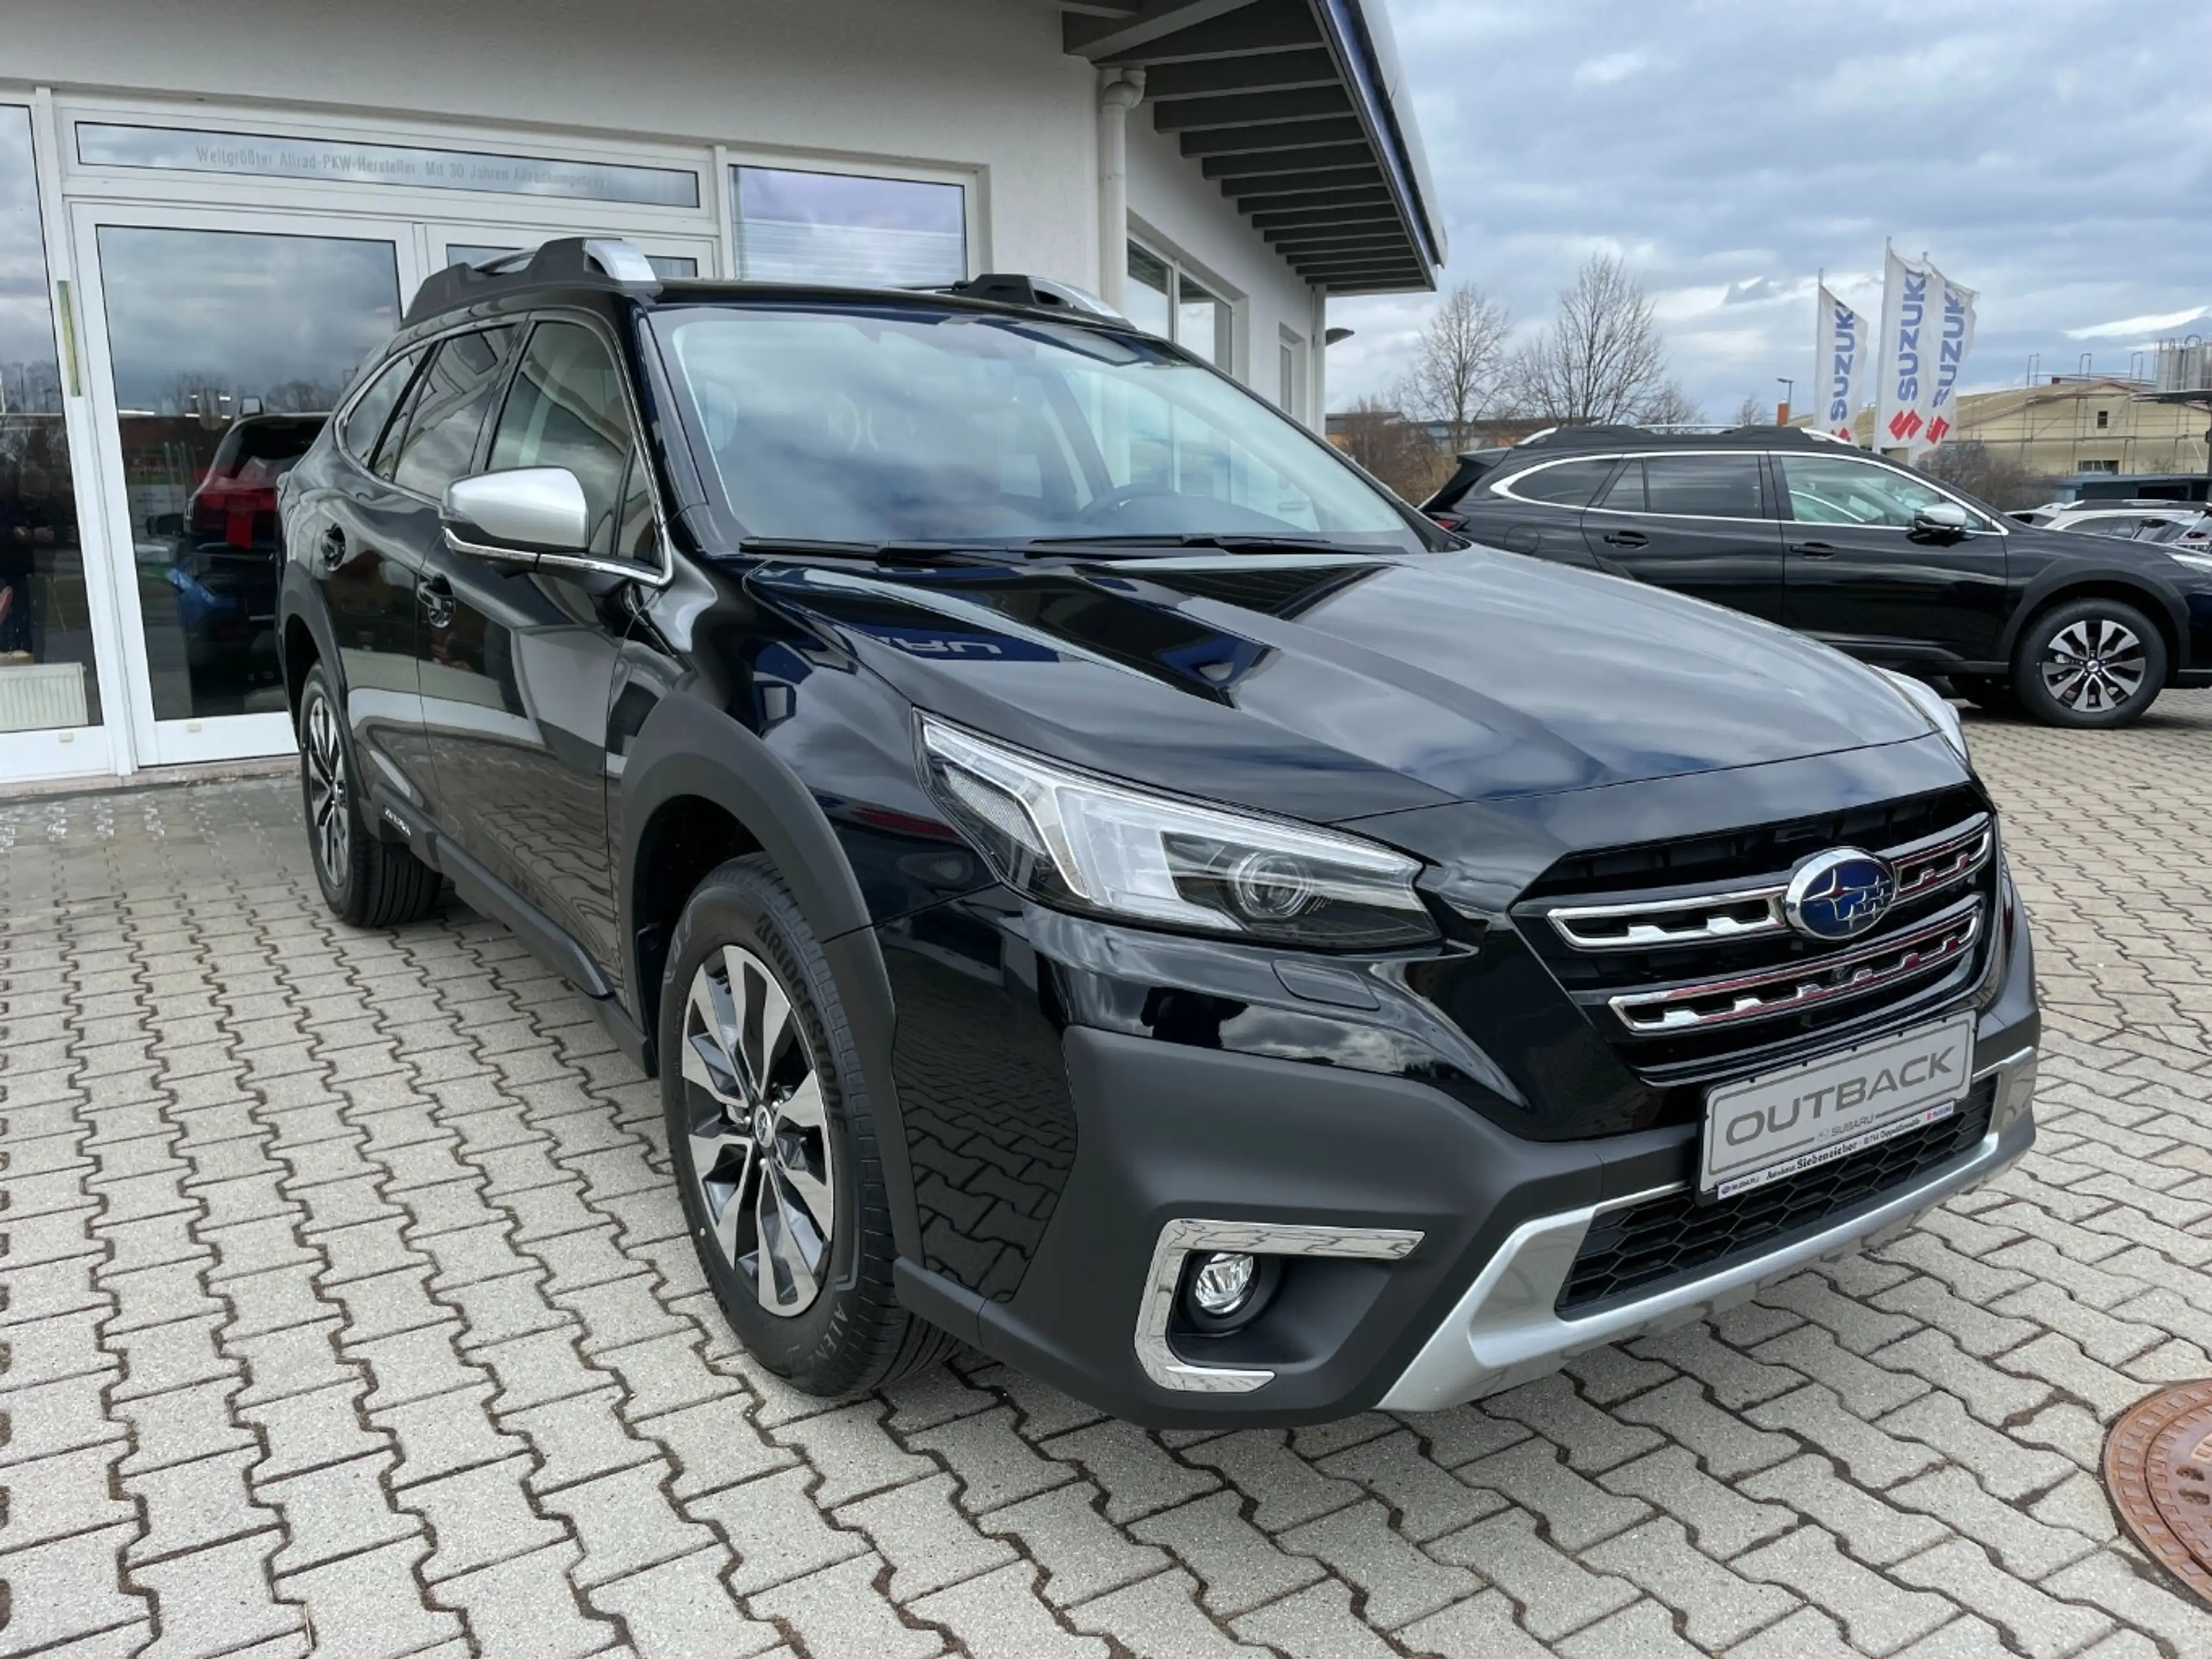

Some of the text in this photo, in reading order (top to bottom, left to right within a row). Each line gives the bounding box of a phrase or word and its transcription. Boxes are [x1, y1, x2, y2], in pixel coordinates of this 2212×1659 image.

[425, 160, 445, 176] Mit
[448, 162, 465, 180] 30
[470, 164, 509, 183] Jahren
[1897, 268, 1927, 402] SUZUKI
[754, 912, 849, 1132] BRIDGESTONE
[1726, 1046, 1954, 1146] OUTBACK
